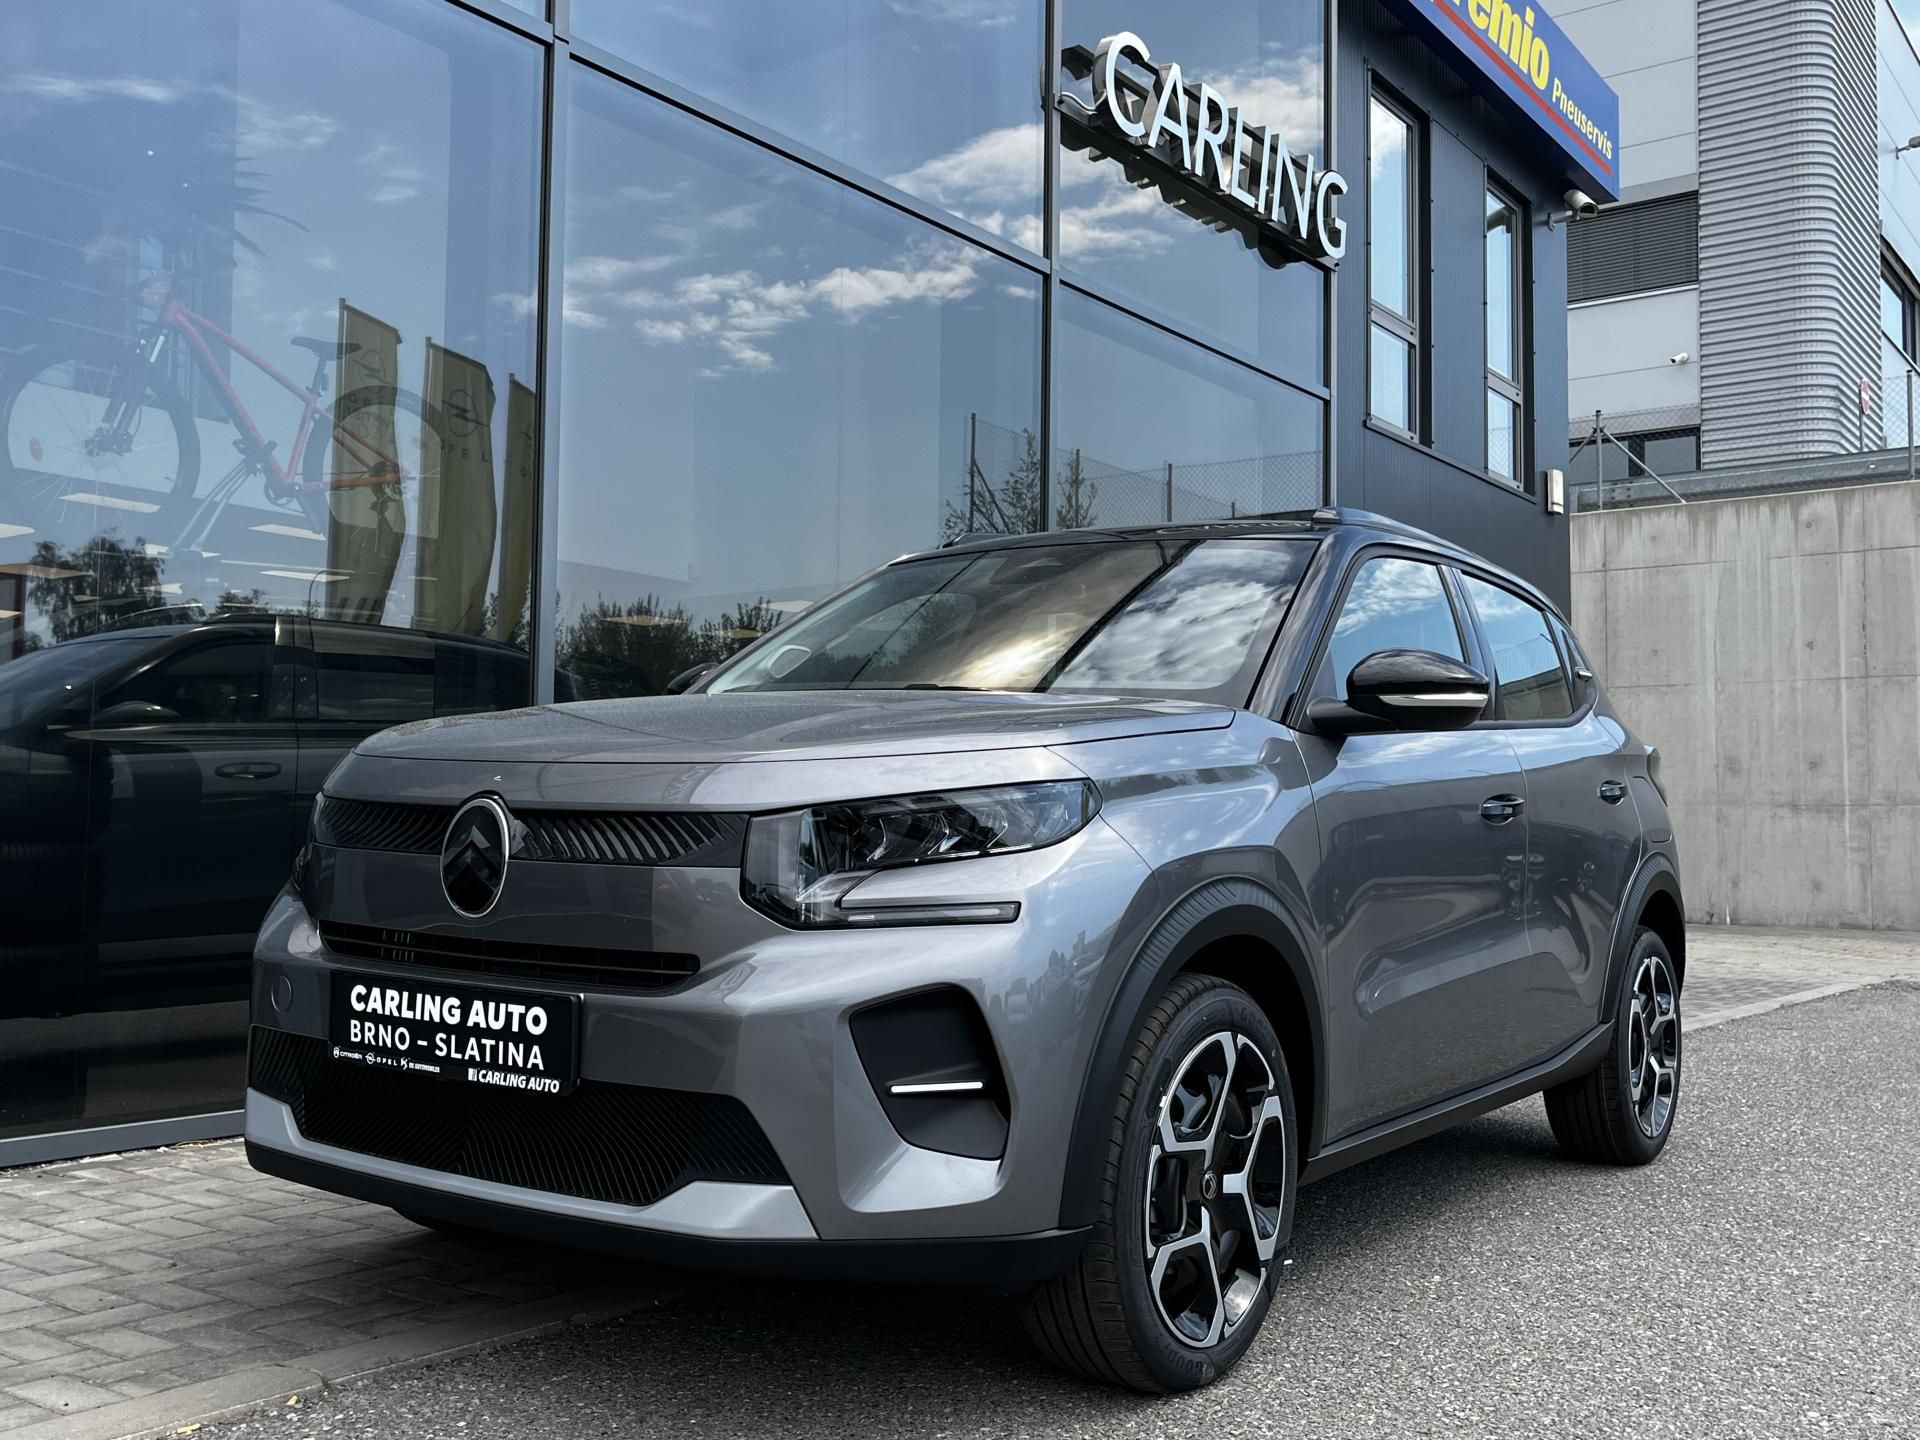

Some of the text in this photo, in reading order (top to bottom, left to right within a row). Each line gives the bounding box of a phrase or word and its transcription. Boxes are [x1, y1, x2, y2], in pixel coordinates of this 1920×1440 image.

[1430, 0, 1549, 90] emio
[1552, 77, 1613, 160] Pneuservis
[1104, 31, 1349, 259] CARLING
[351, 984, 548, 1035] CARLING AUTO
[350, 1019, 410, 1050] BRNO
[435, 1032, 544, 1070] SLATINA
[376, 1056, 398, 1067] OPEL
[478, 1069, 560, 1094] CARLING AUTO
